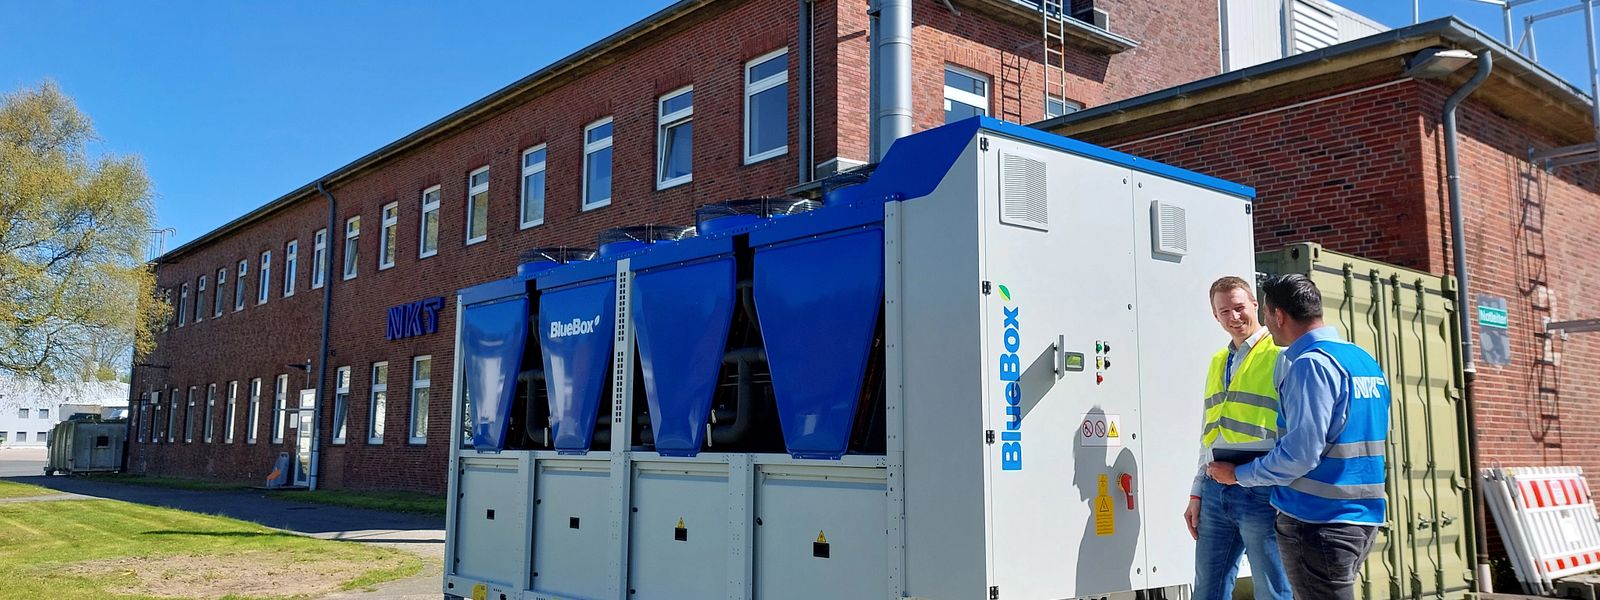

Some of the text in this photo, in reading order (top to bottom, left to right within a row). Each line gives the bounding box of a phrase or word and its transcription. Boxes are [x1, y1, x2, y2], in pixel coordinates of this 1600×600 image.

[386, 297, 445, 341] NKT
[550, 318, 594, 338] BlueBox
[999, 305, 1022, 471] BlueBox
